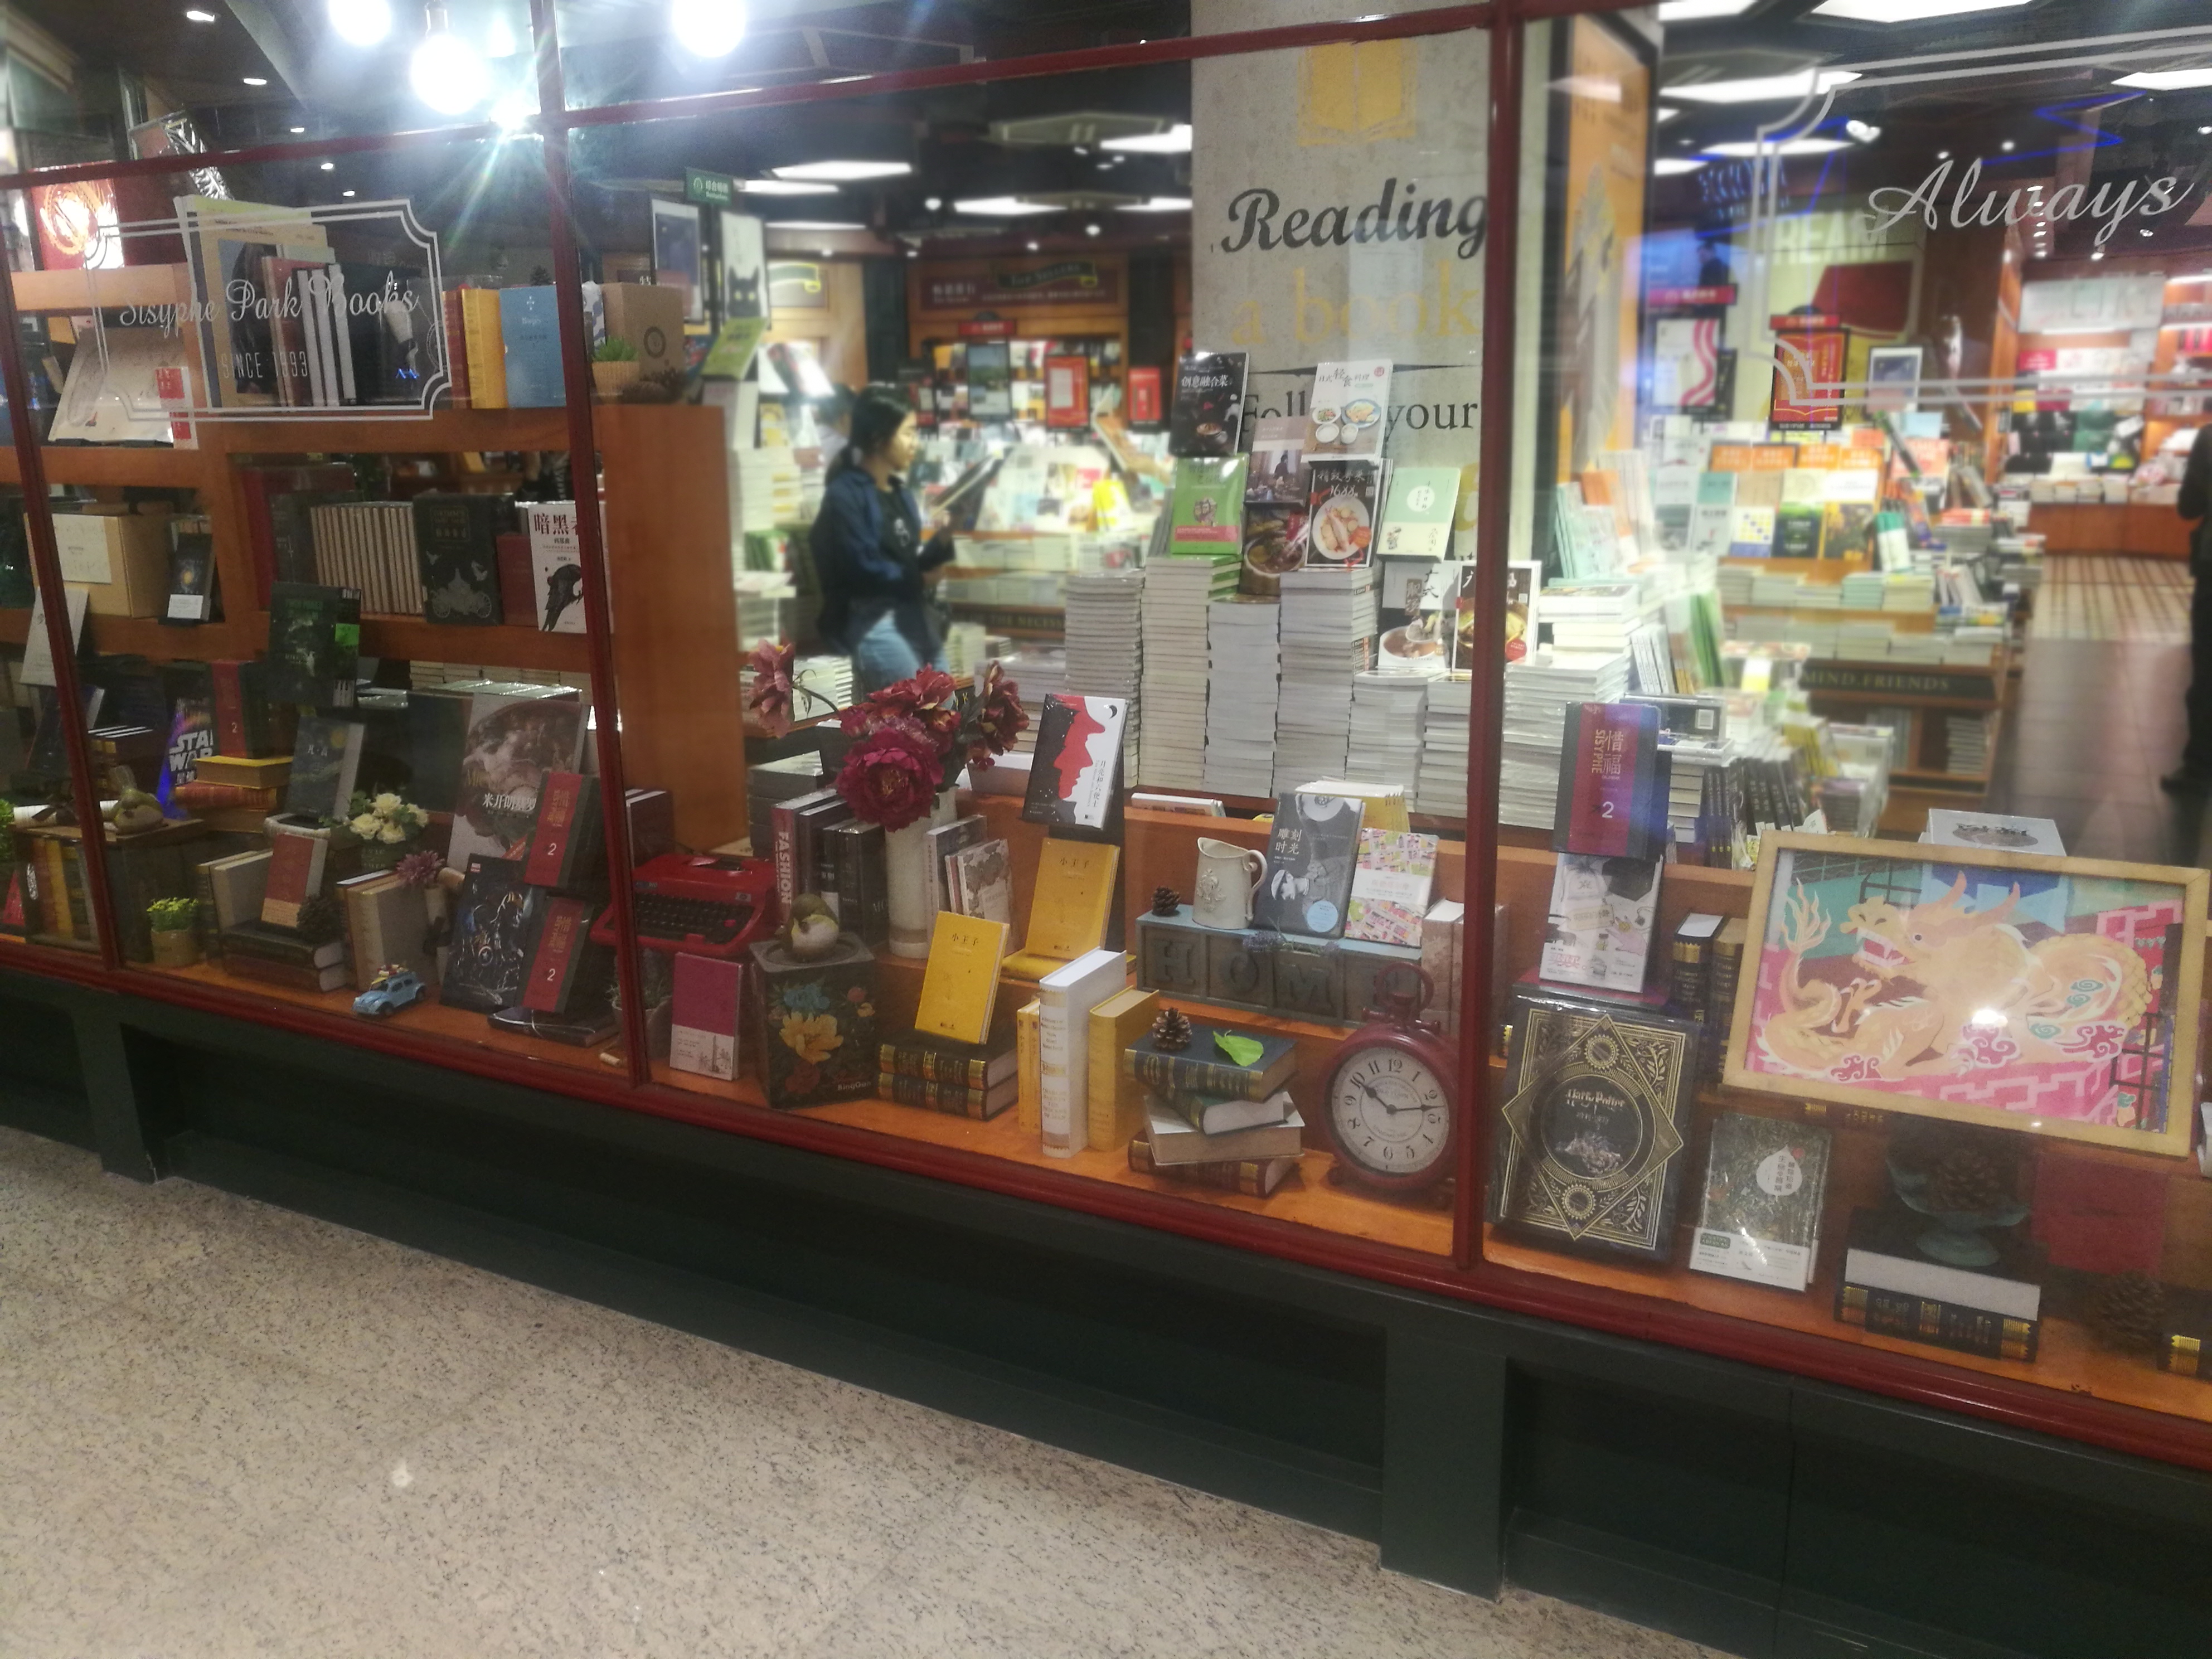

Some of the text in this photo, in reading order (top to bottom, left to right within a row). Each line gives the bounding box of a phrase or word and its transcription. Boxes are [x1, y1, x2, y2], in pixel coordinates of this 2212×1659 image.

[1868, 157, 2195, 246] Always
[1221, 177, 1487, 260] Reading
[119, 270, 420, 339] Sisyphe Park Books
[1231, 260, 1484, 345] a book
[221, 351, 310, 379] SINCE 1993
[1591, 729, 1606, 774] SISYPHE
[1093, 759, 1107, 808] 月亮和六便士
[1602, 801, 1614, 819] 2
[547, 842, 557, 856] 2
[778, 831, 792, 904] FASHION
[952, 933, 979, 947] 小王子
[547, 968, 556, 982] 2
[1368, 1060, 1381, 1075] 11
[1388, 1059, 1403, 1073] 12
[1350, 1071, 1366, 1089] 10
[1565, 1089, 1626, 1115] Harry Potter
